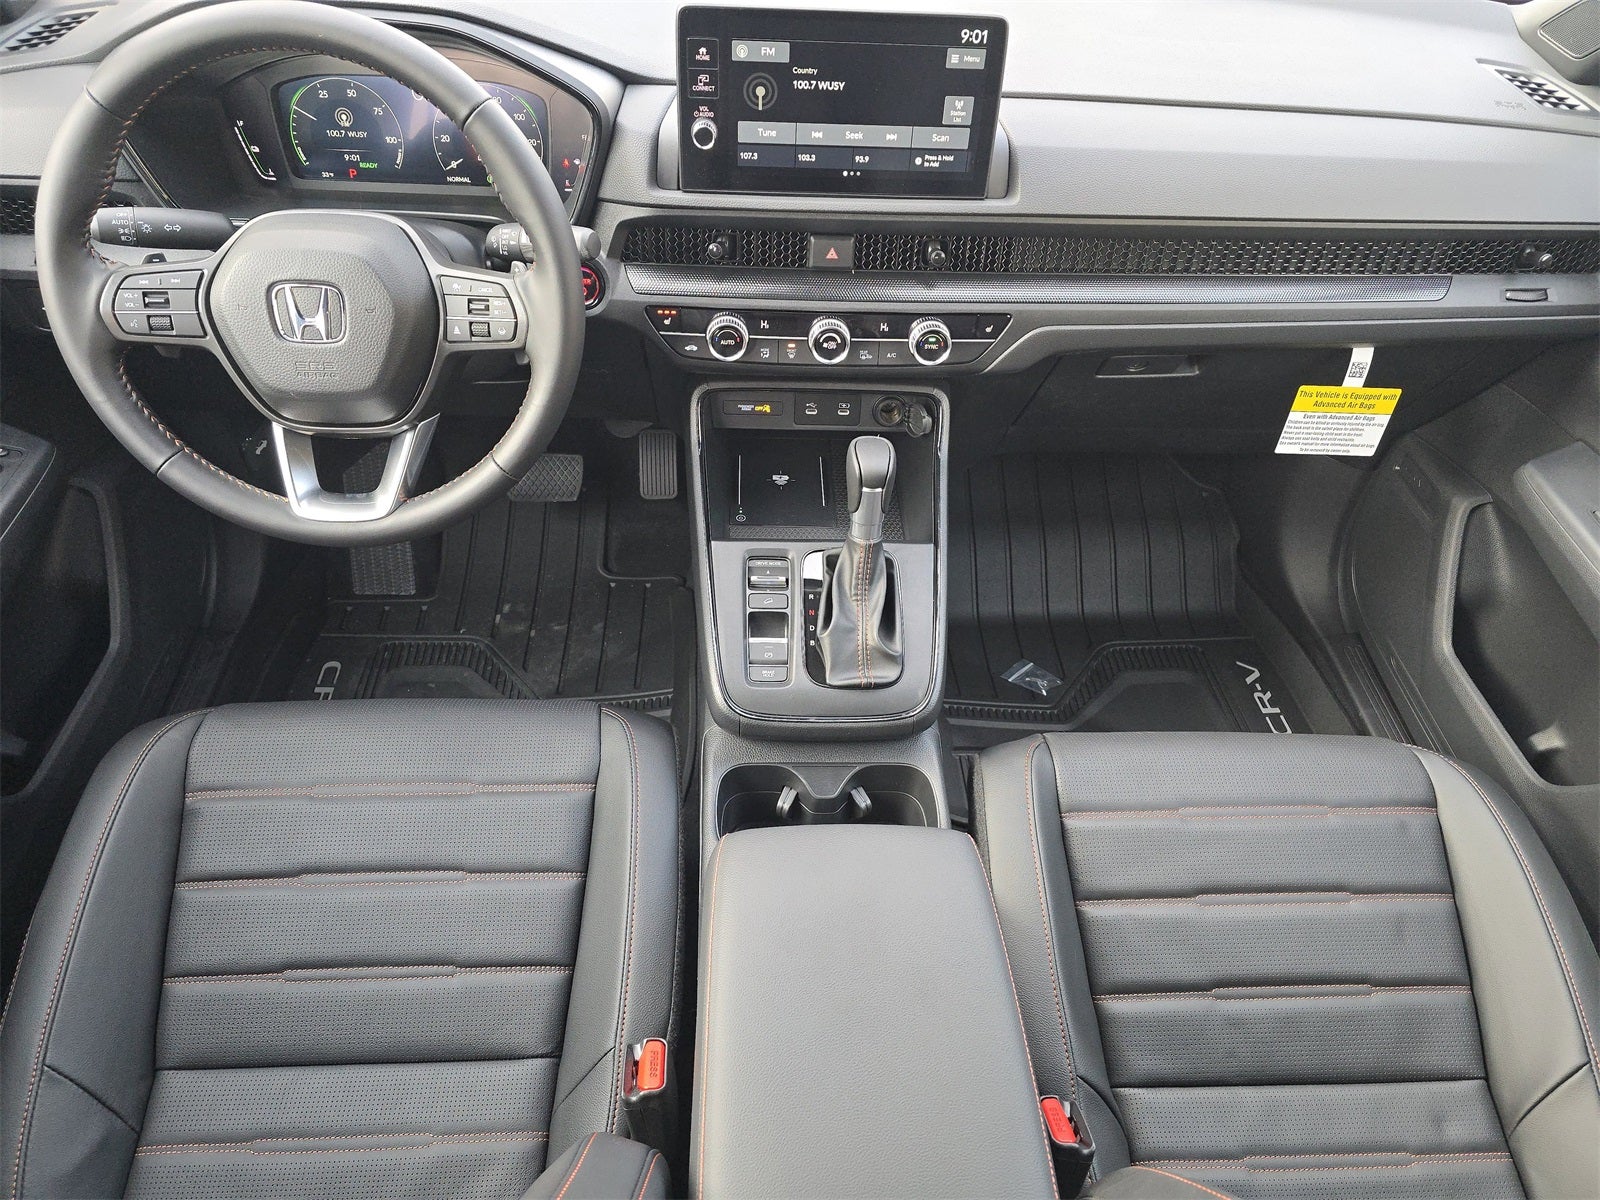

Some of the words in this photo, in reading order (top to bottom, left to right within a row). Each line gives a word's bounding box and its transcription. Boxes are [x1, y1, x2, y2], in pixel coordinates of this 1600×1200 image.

[961, 28, 989, 44] 9:01
[761, 47, 776, 57] FM
[963, 55, 981, 63] Menu
[792, 66, 818, 76] Country
[793, 80, 817, 90] 100.7
[817, 80, 846, 91] WUSY
[318, 90, 329, 99] 25
[346, 89, 357, 97] 50
[372, 107, 383, 116] 75
[513, 113, 526, 121] 100
[326, 129, 346, 138] 100.7
[347, 131, 368, 139] WUSY
[757, 127, 777, 137] Tune
[845, 130, 864, 140] Seek
[384, 136, 398, 144] 100
[440, 134, 450, 143] 20
[932, 133, 950, 142] Scan
[343, 154, 361, 162] 9:01
[739, 151, 758, 160] 107.3
[797, 154, 816, 162] 103.3
[855, 155, 870, 163] 93.9
[349, 168, 357, 179] P
[1299, 390, 1314, 398] This
[1315, 391, 1340, 399] Vehicle
[1350, 392, 1382, 401] Equipped
[1383, 393, 1398, 401] with
[1313, 400, 1346, 409] Advanced
[1359, 402, 1376, 410] Bags
[1236, 661, 1292, 734] CR-V
